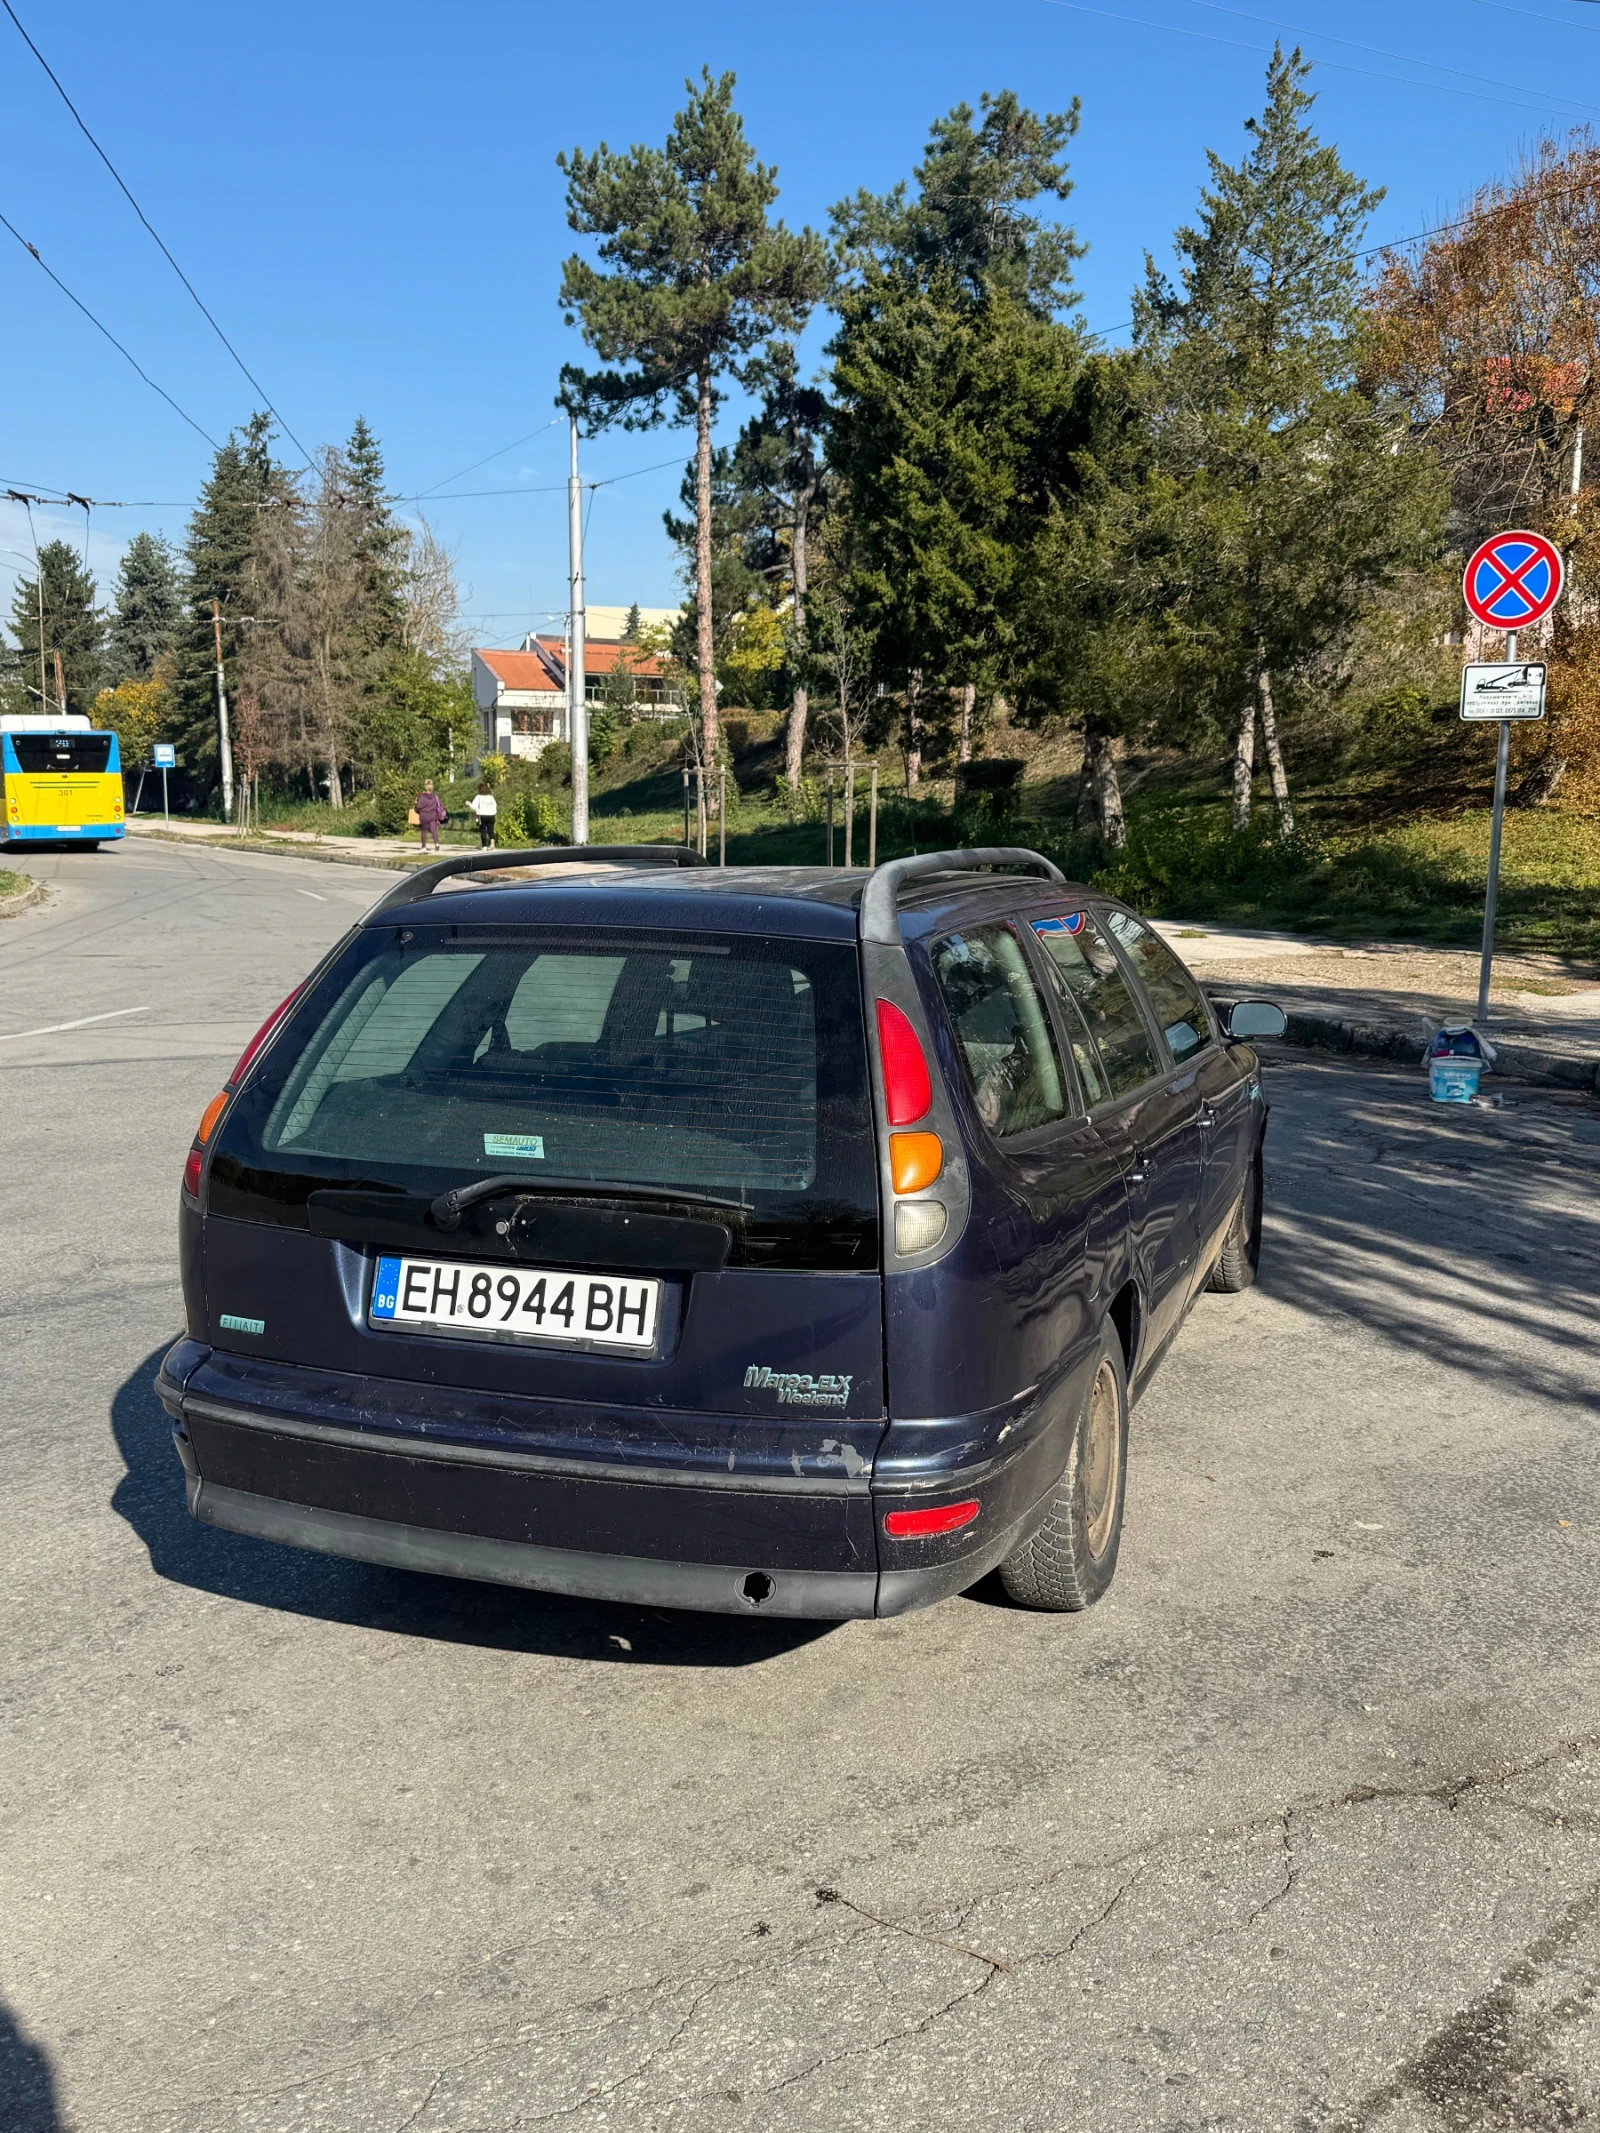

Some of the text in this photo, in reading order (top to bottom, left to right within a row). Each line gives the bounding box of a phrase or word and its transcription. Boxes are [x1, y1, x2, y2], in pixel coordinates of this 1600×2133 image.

[492, 1135, 537, 1146] SEMAUTO
[377, 1294, 395, 1309] BG
[222, 1317, 262, 1332] FIAT
[743, 1364, 853, 1391] Marea ELX
[777, 1388, 850, 1406] Weekend
